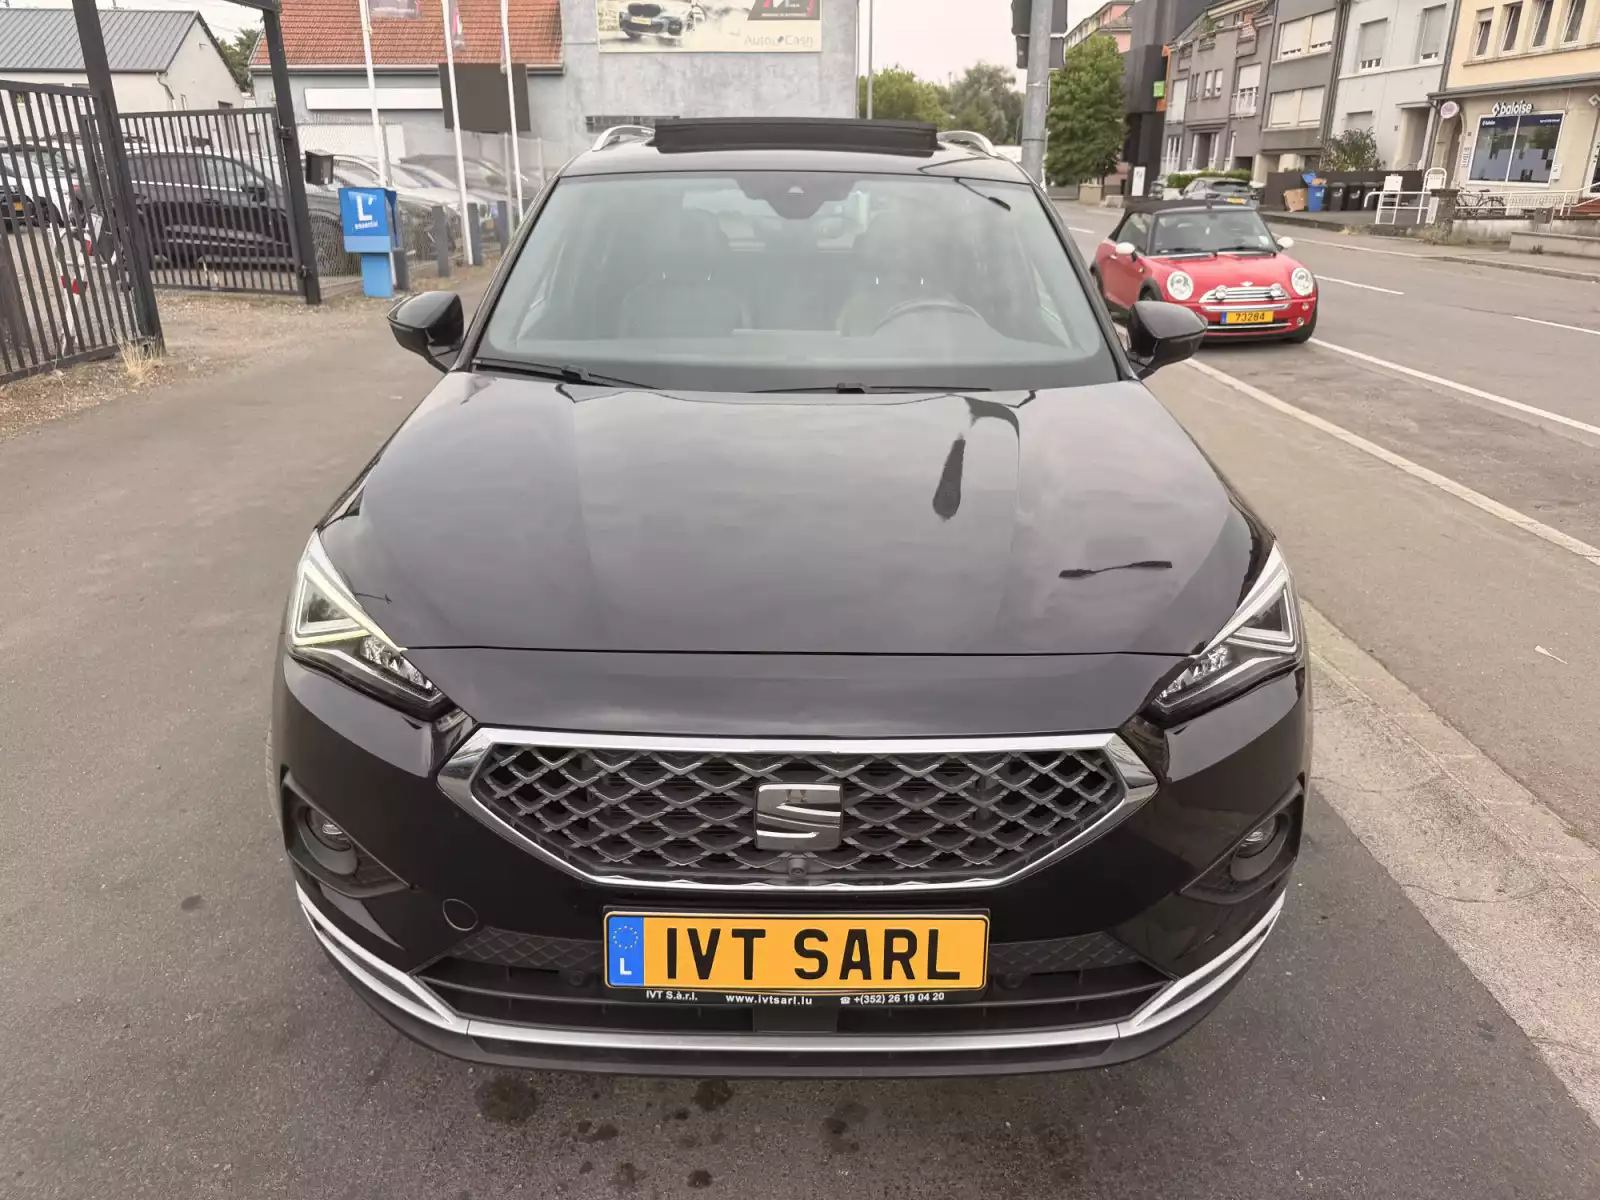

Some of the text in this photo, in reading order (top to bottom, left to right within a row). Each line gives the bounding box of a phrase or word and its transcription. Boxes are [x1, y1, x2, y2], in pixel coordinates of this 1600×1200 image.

[1500, 100, 1532, 115] baloise
[1235, 312, 1265, 322] 73284
[666, 927, 960, 980] IVT SARL
[619, 957, 632, 976] L
[646, 990, 663, 999] IVT
[725, 993, 813, 1005] www.ivtsarl.lu
[854, 994, 885, 1004] +(352)
[888, 993, 901, 1003] 26
[904, 993, 916, 1002] 19
[918, 993, 930, 1002] 04
[932, 992, 945, 1001] 20
